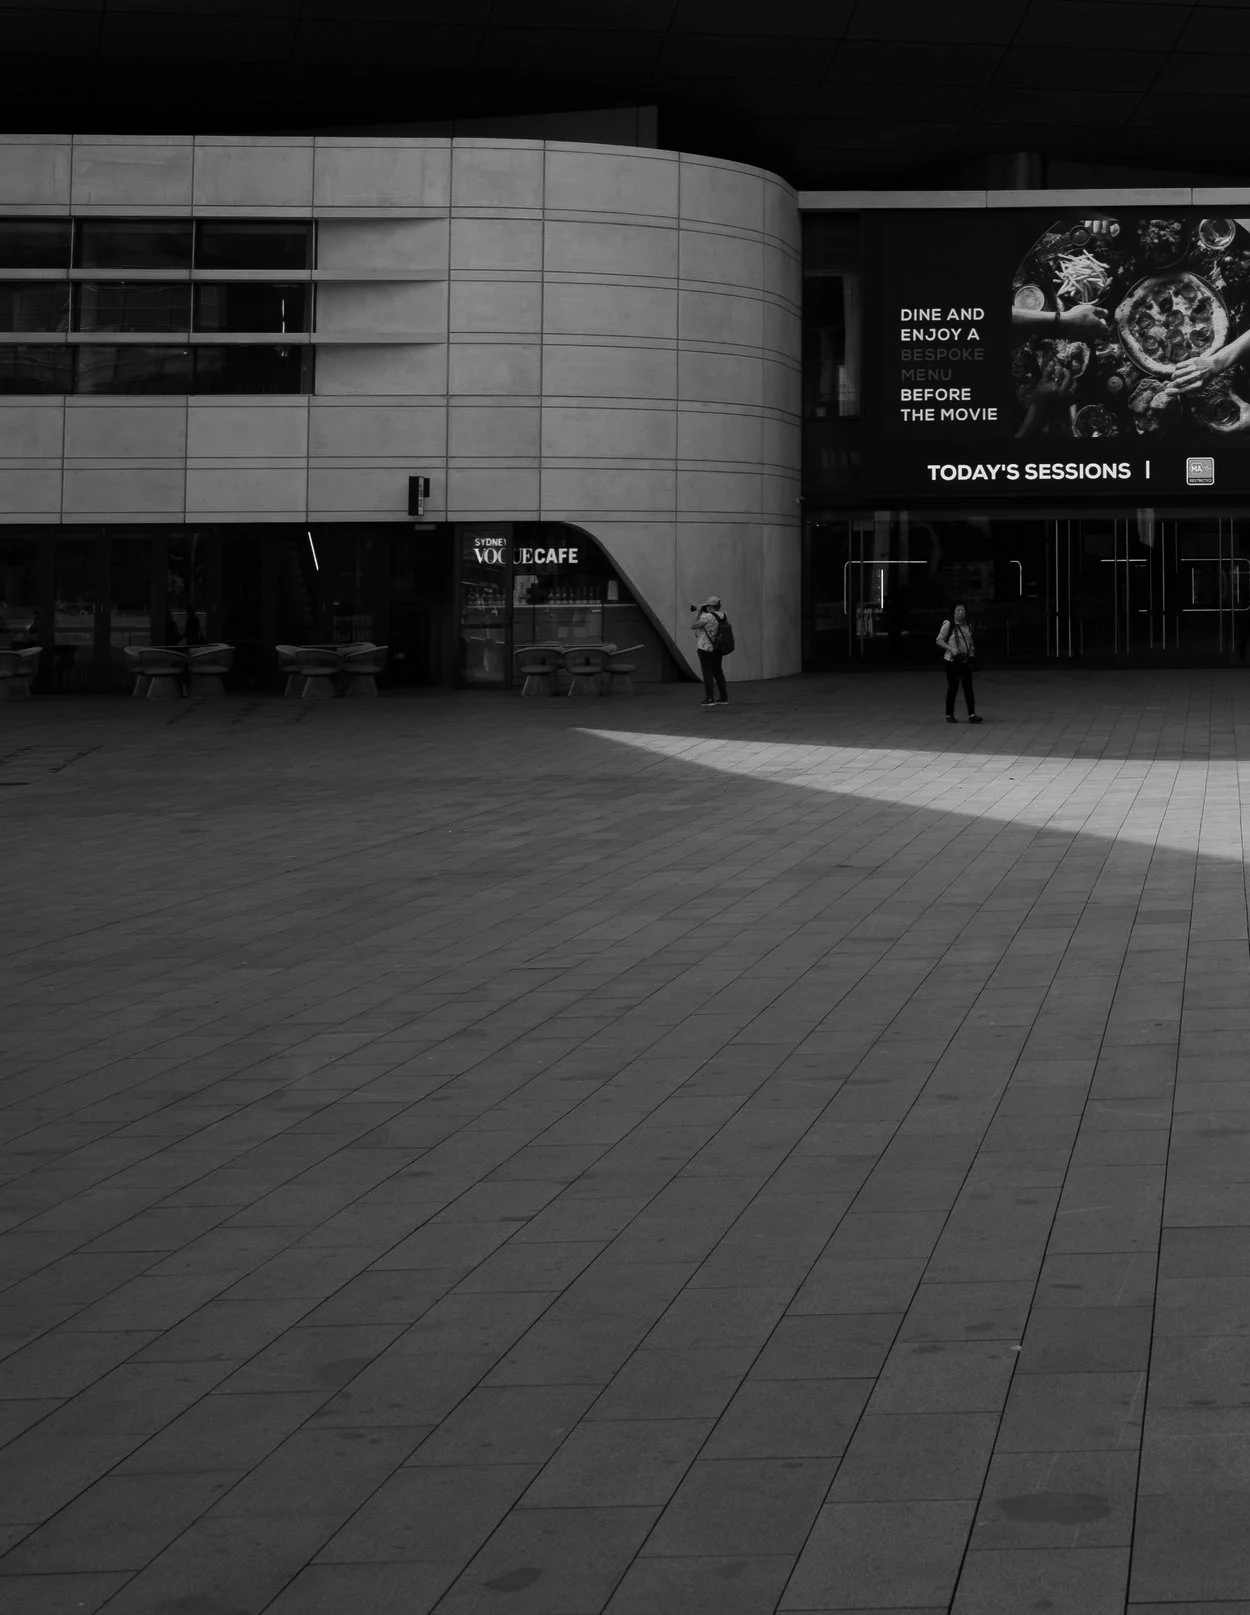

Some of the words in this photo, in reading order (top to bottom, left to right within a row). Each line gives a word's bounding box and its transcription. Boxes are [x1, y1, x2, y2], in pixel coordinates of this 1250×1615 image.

[901, 309, 942, 322] DINE
[946, 308, 985, 321] AND
[901, 328, 962, 342] ENJOY
[966, 328, 980, 341] A
[901, 348, 984, 361] BESPOKE
[901, 368, 952, 381] MENU
[901, 388, 972, 401] BEFORE
[900, 408, 936, 422] THE
[940, 407, 998, 421] MOVIE
[928, 462, 1020, 481] TODAY'S
[1024, 462, 1132, 480] SESSIONS
